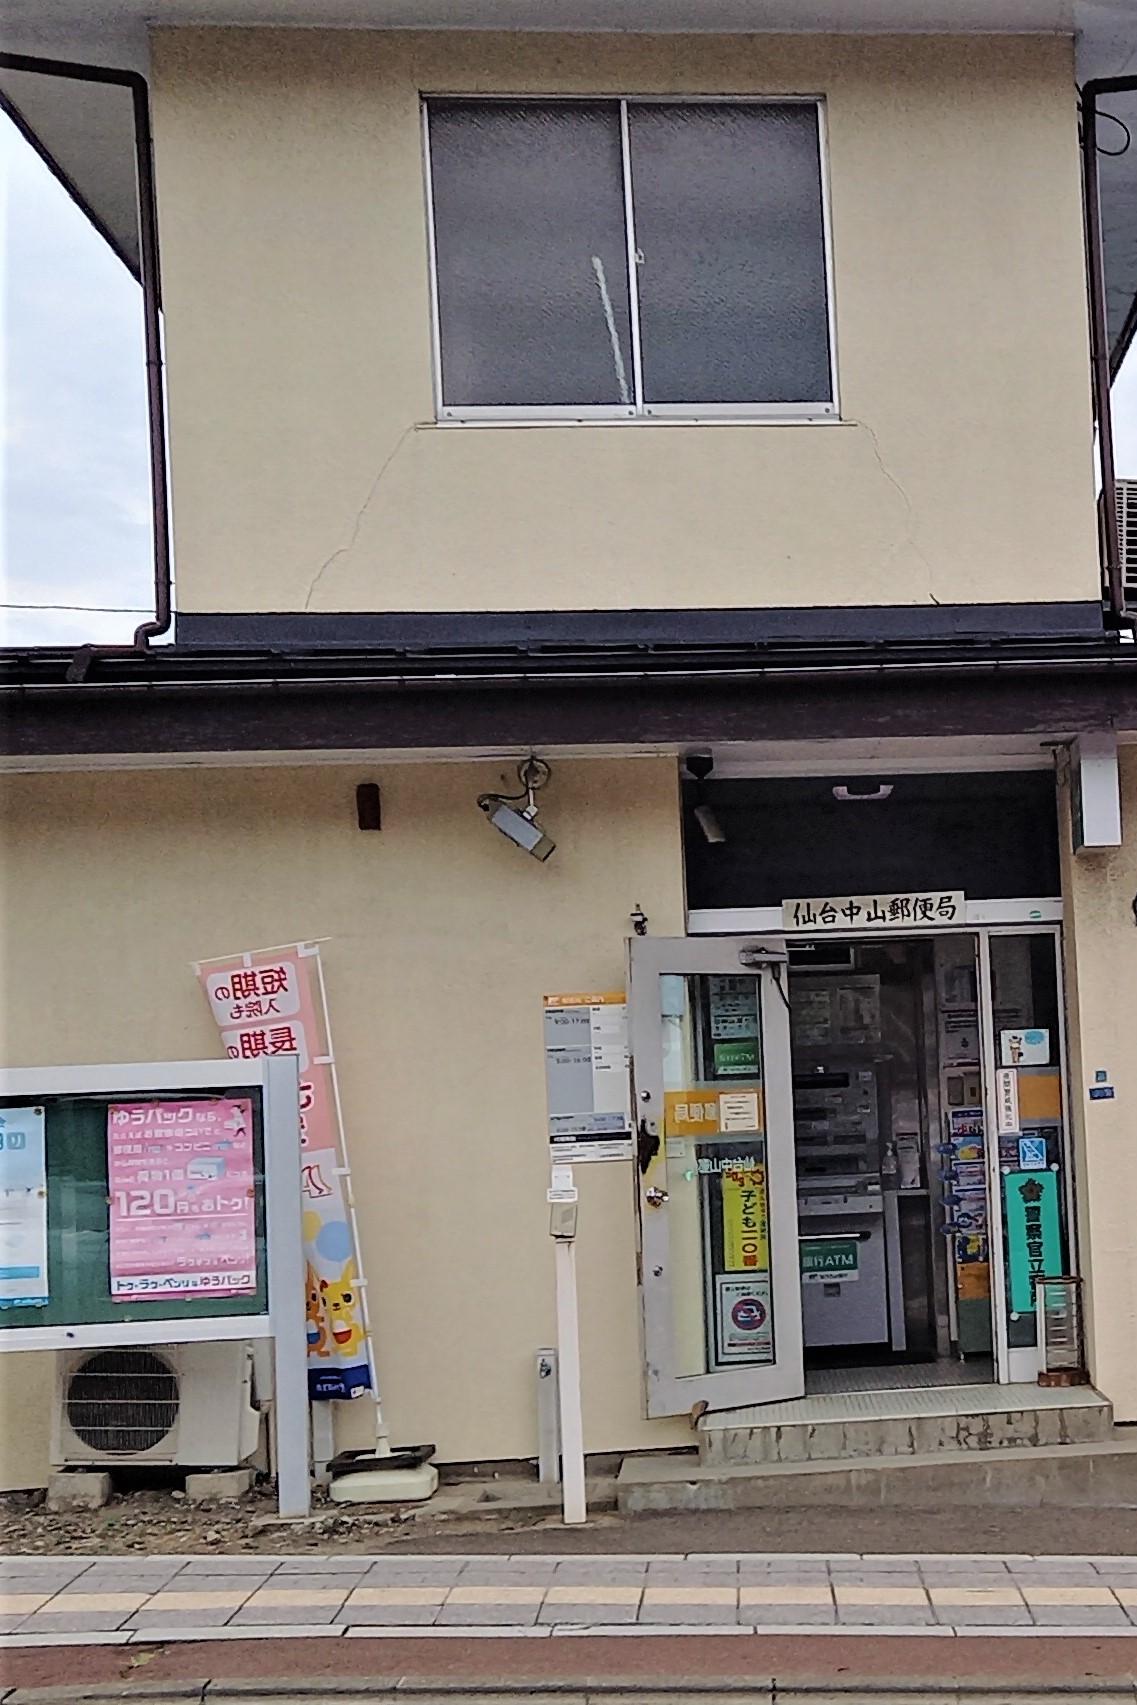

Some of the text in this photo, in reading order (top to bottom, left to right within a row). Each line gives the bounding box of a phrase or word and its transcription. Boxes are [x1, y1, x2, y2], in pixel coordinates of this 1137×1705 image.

[793, 896, 957, 927] 仙台中山郵便局
